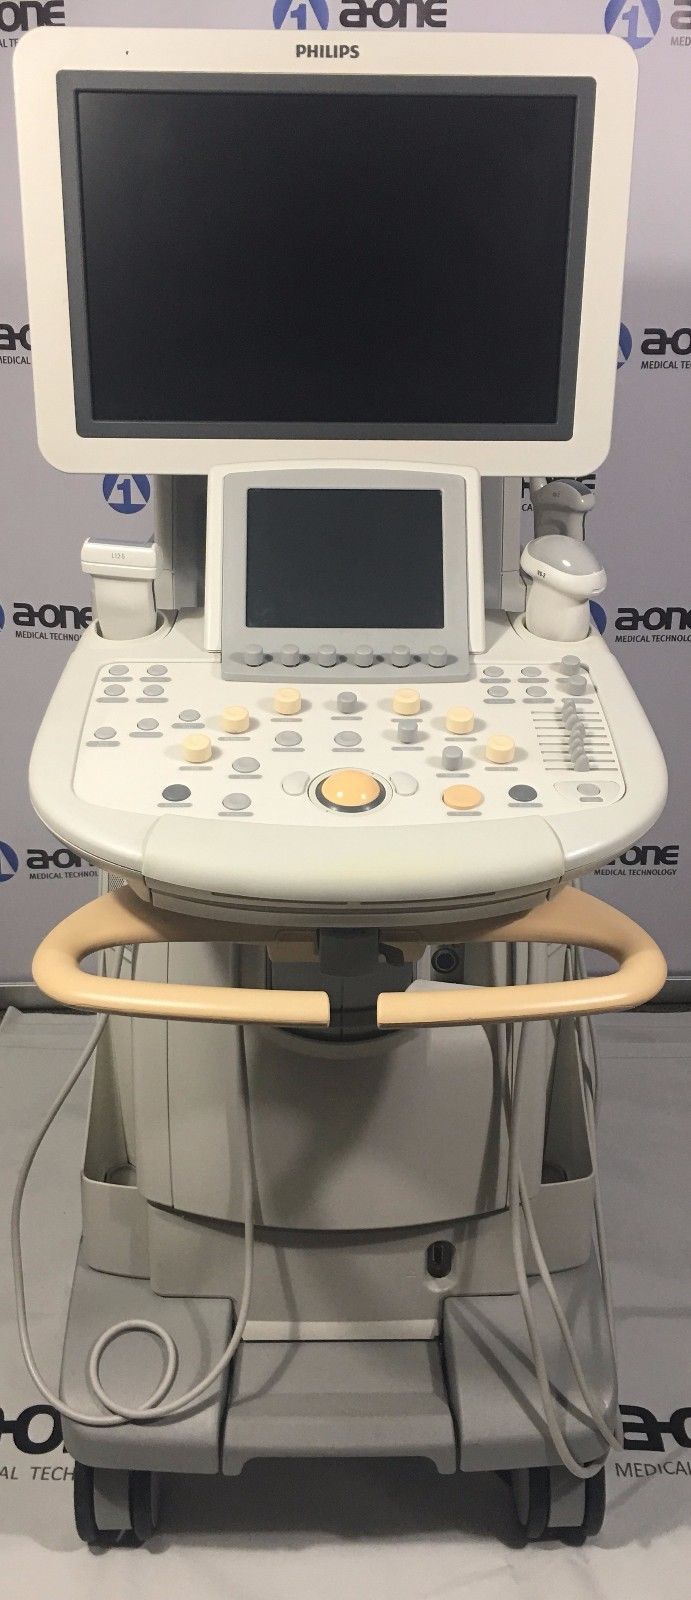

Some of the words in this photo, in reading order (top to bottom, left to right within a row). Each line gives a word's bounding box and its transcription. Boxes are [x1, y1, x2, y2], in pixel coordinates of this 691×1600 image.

[296, 44, 360, 58] PHILIPS
[641, 361, 679, 369] MEDICAL
[15, 630, 48, 640] MEDICAL
[50, 632, 81, 641] TECHNO
[615, 634, 650, 643] MEDICAL
[29, 872, 63, 880] MEDICAL
